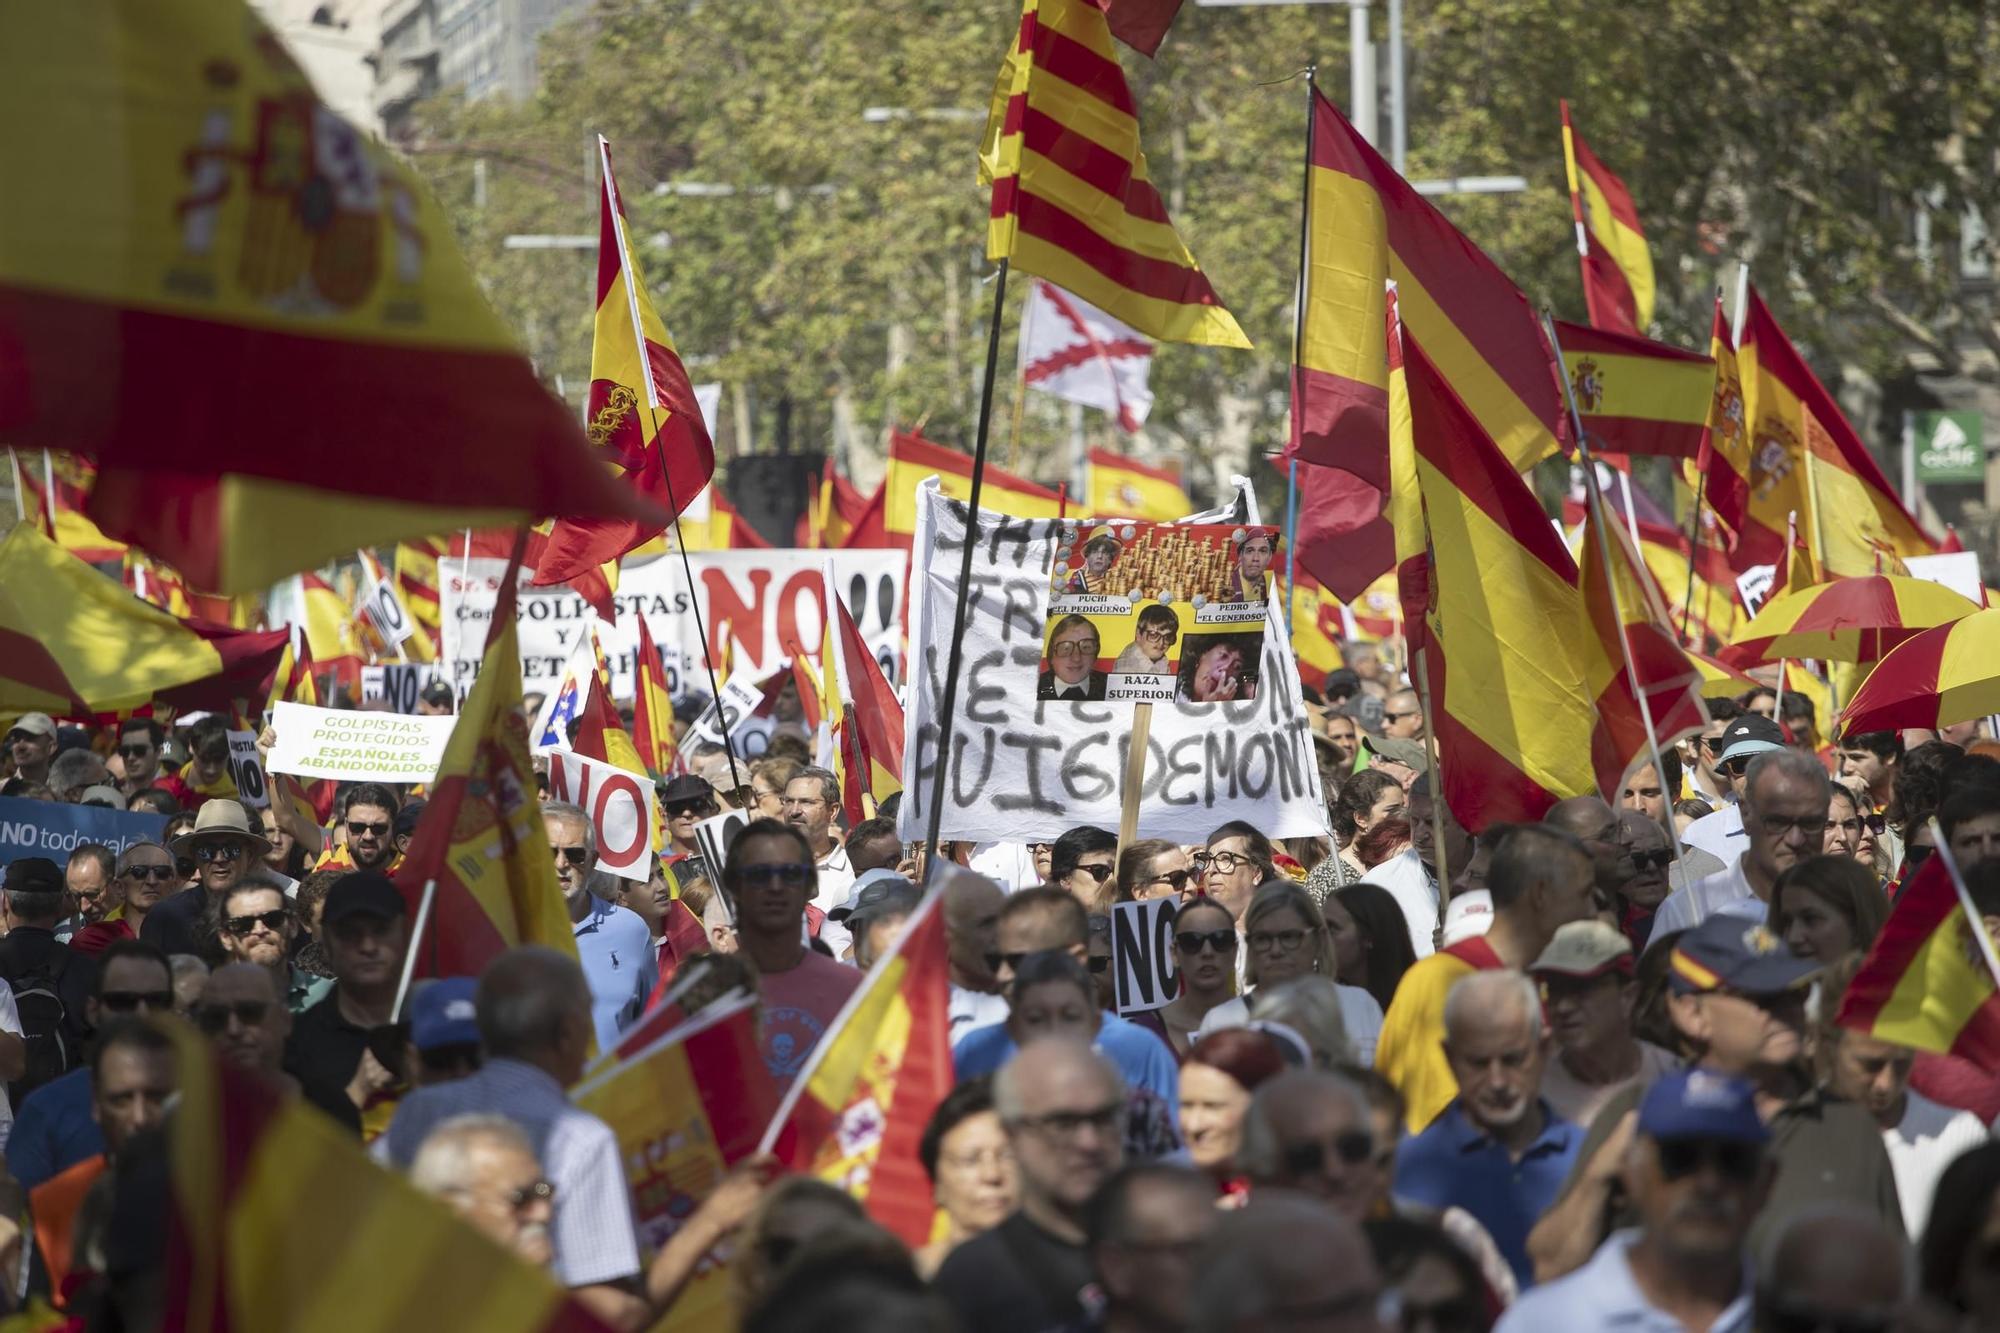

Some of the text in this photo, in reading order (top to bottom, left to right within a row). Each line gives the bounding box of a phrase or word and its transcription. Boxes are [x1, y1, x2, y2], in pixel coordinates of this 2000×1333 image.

[1078, 595, 1108, 603] PUCHI
[1219, 603, 1249, 611] PEDRO
[1124, 676, 1161, 686] RAZA
[1108, 690, 1173, 700] SUPERIOR
[324, 716, 423, 734] GOLPISTAS
[312, 729, 431, 746] PROTEGIDOS
[318, 746, 421, 762] ESPAÑOLES
[298, 757, 438, 773] ABANDONADOS
